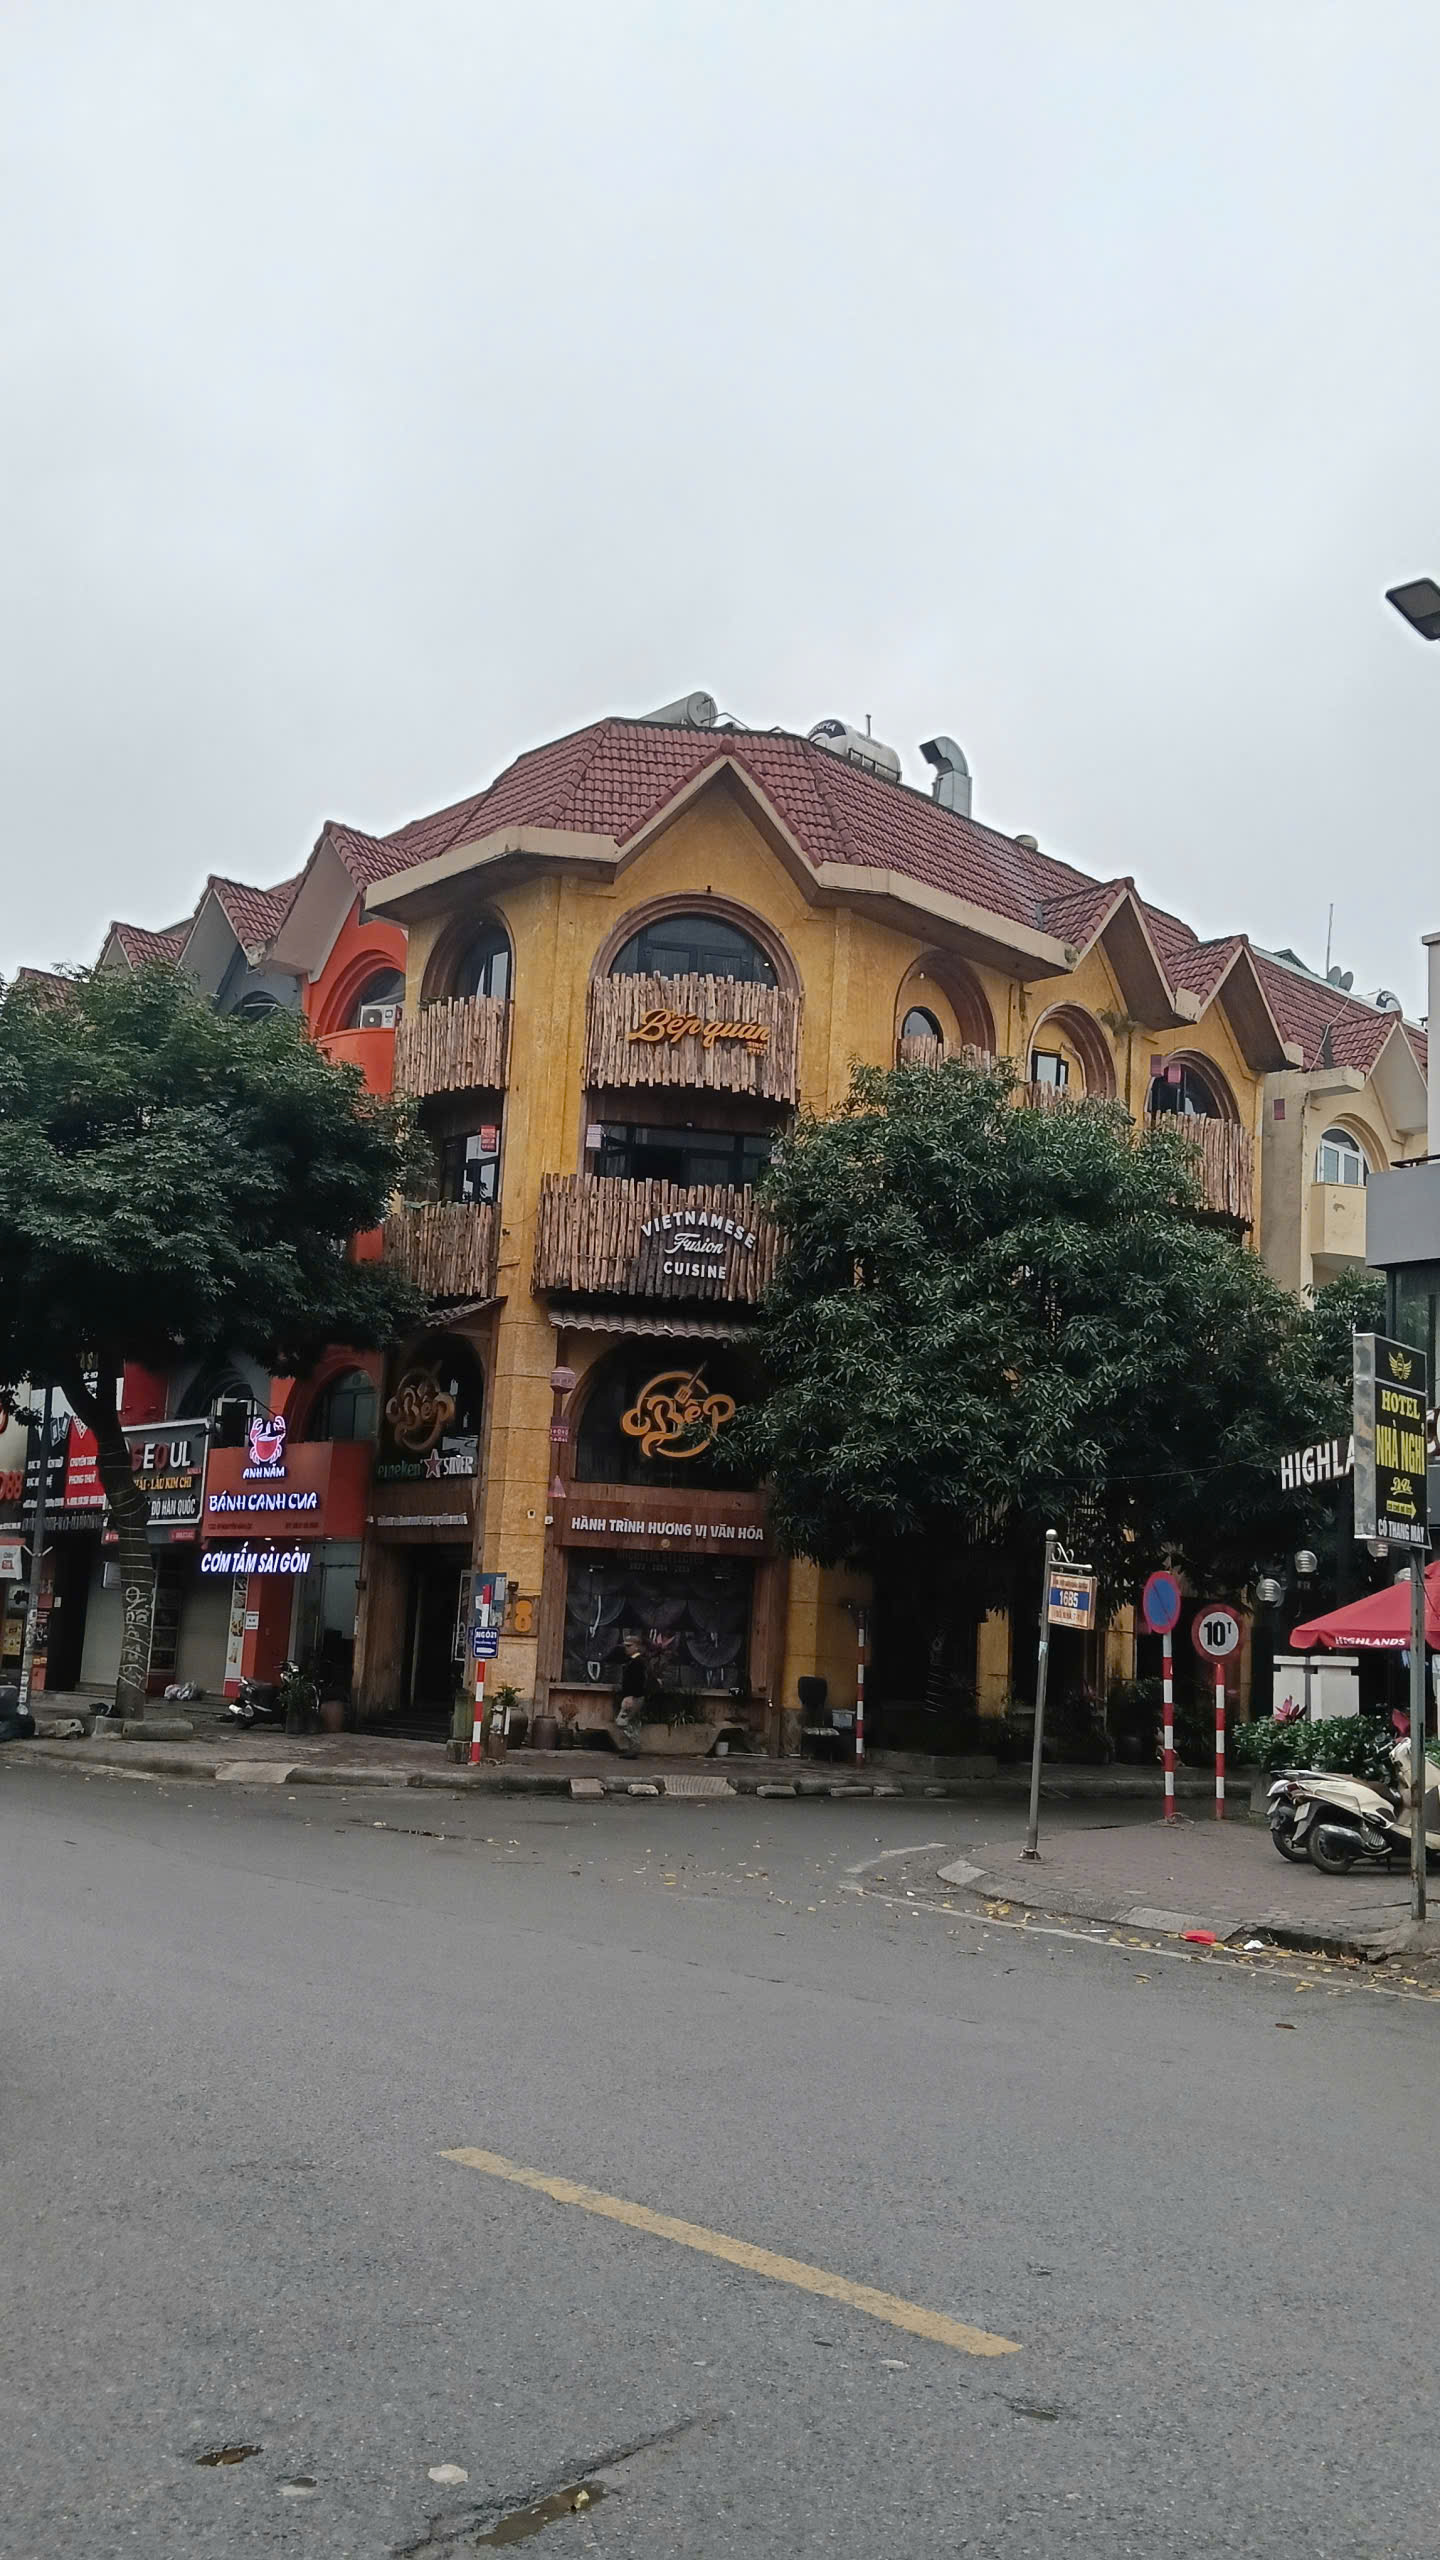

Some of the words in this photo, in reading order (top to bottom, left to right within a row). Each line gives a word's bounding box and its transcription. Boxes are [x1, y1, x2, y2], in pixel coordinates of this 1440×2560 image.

[628, 1008, 701, 1043] Bếp
[703, 1020, 771, 1048] quán
[641, 1211, 756, 1249] VIETNAMESE
[664, 1232, 724, 1254] Fusion
[664, 1261, 727, 1280] CUISINE
[1381, 1389, 1421, 1420] HOTEL
[1376, 1419, 1399, 1470] NHÀ
[1401, 1424, 1425, 1476] NGHỈ
[242, 1467, 262, 1479] ANH
[263, 1463, 285, 1478] NĂM
[377, 1459, 422, 1479] eineken
[162, 1496, 176, 1517] HÀN
[177, 1493, 196, 1517] QUỐC
[209, 1490, 246, 1512] BÁNH
[248, 1493, 286, 1511] CANH
[288, 1492, 317, 1509] CUA
[571, 1515, 606, 1532] HÀNH
[609, 1518, 645, 1534] TRÌNH
[648, 1521, 692, 1537] HƯƠNG
[695, 1524, 707, 1540] VỊ
[710, 1523, 735, 1539] VĂN
[738, 1524, 764, 1540] HÓA
[1378, 1516, 1388, 1537] CÓ
[1388, 1519, 1410, 1541] THANG
[1411, 1522, 1425, 1543] MÁY
[201, 1550, 232, 1573] CƠM
[232, 1541, 258, 1573] TẤM
[258, 1545, 280, 1573] SÀI
[280, 1545, 311, 1573] GÒN
[1335, 1636, 1406, 1647] HIGHLANDS
